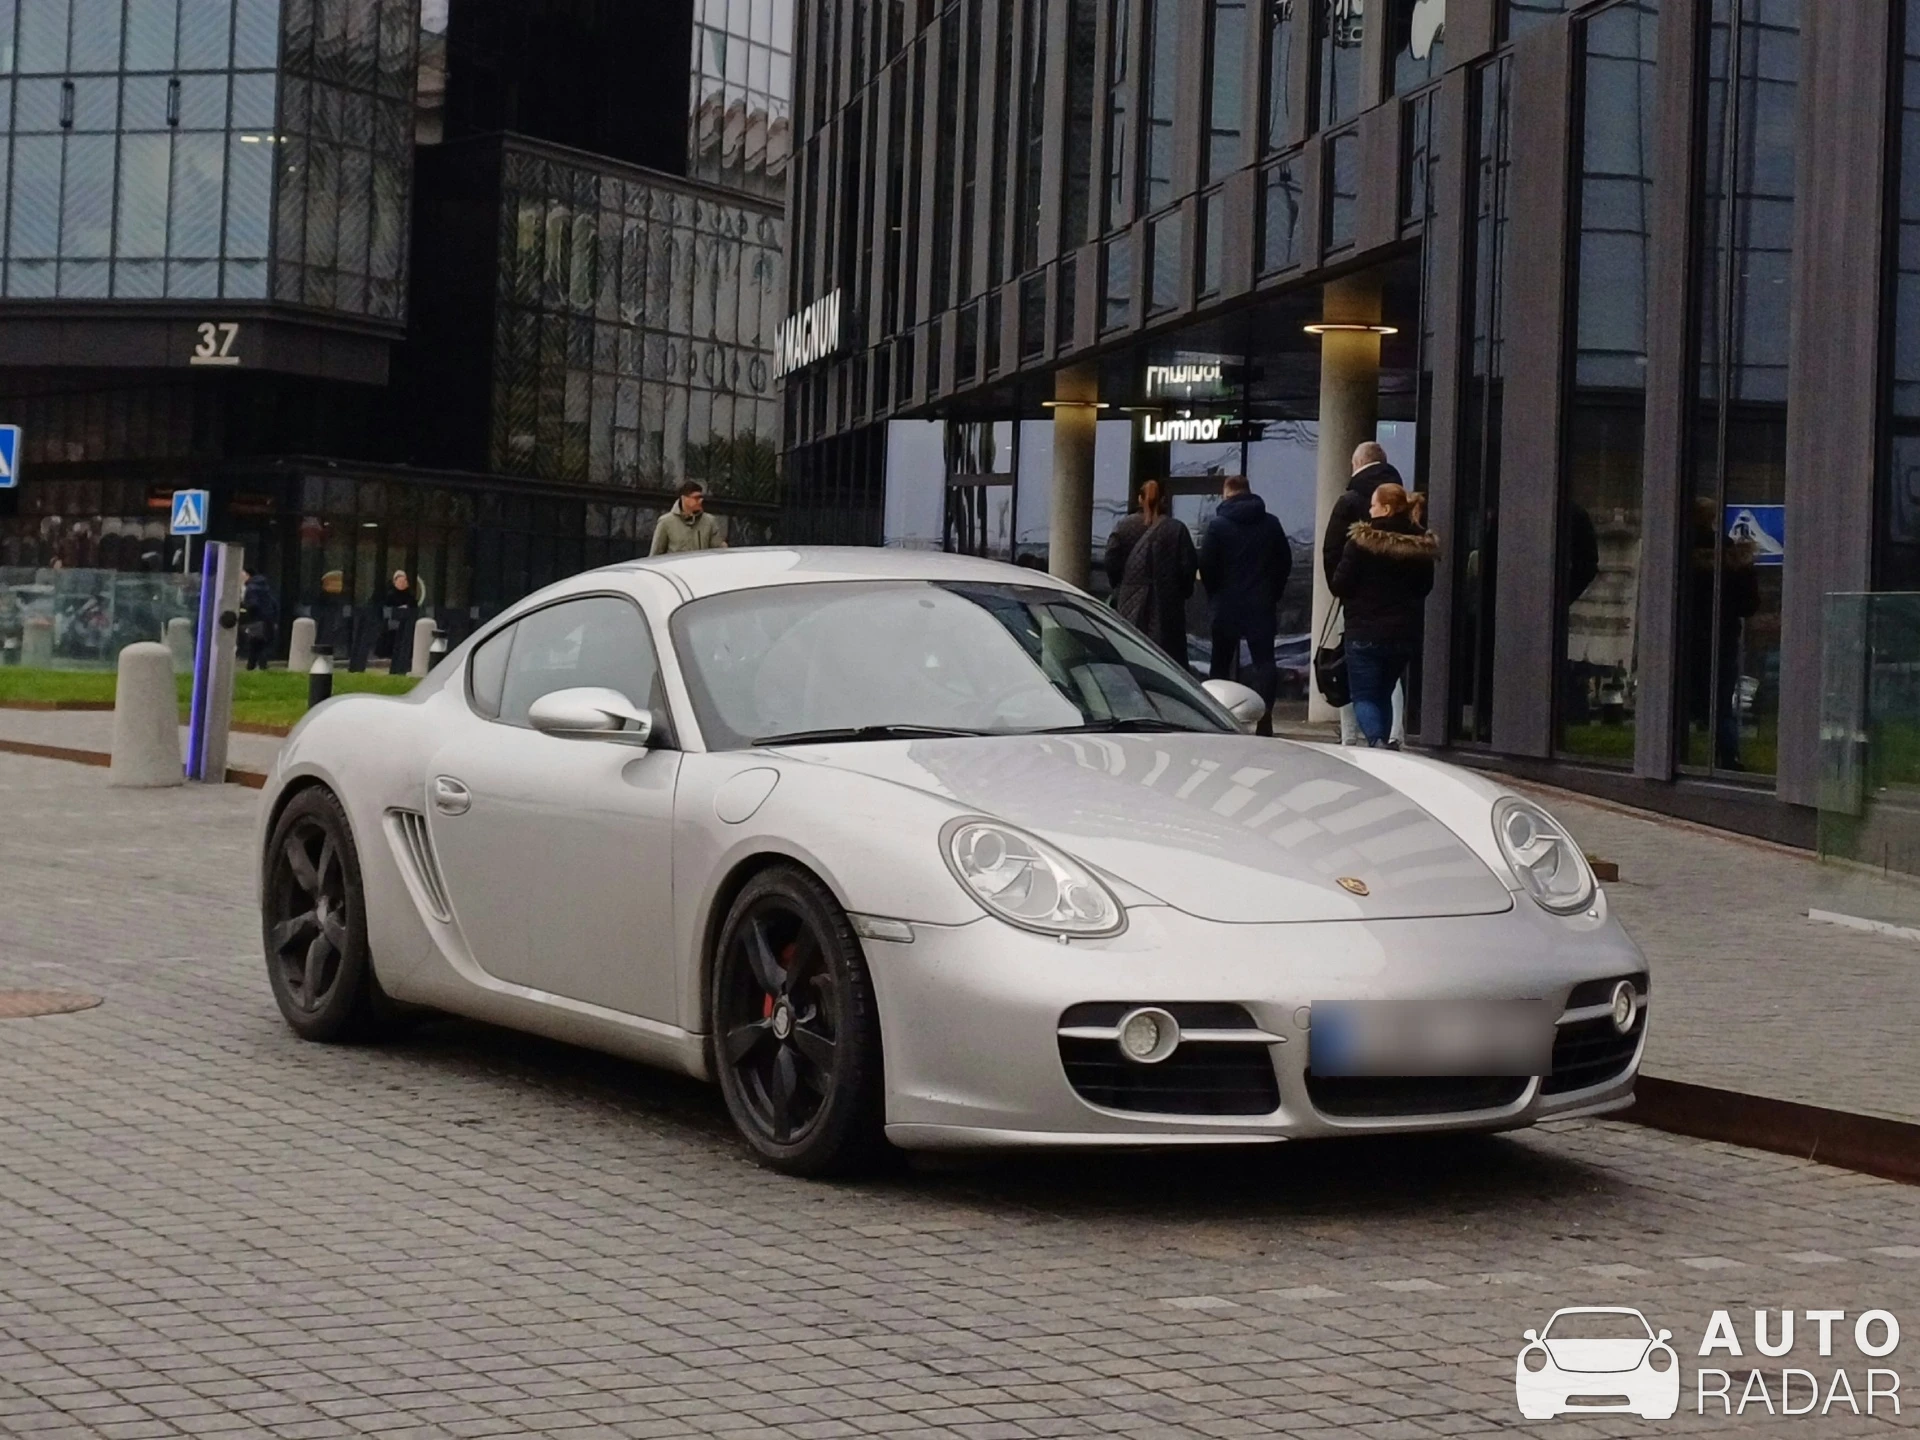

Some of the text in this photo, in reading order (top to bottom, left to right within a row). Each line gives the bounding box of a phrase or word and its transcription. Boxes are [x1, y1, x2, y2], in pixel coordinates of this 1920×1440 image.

[195, 322, 239, 356] 37
[784, 287, 840, 375] MAGNUM
[1144, 410, 1222, 442] Luminor
